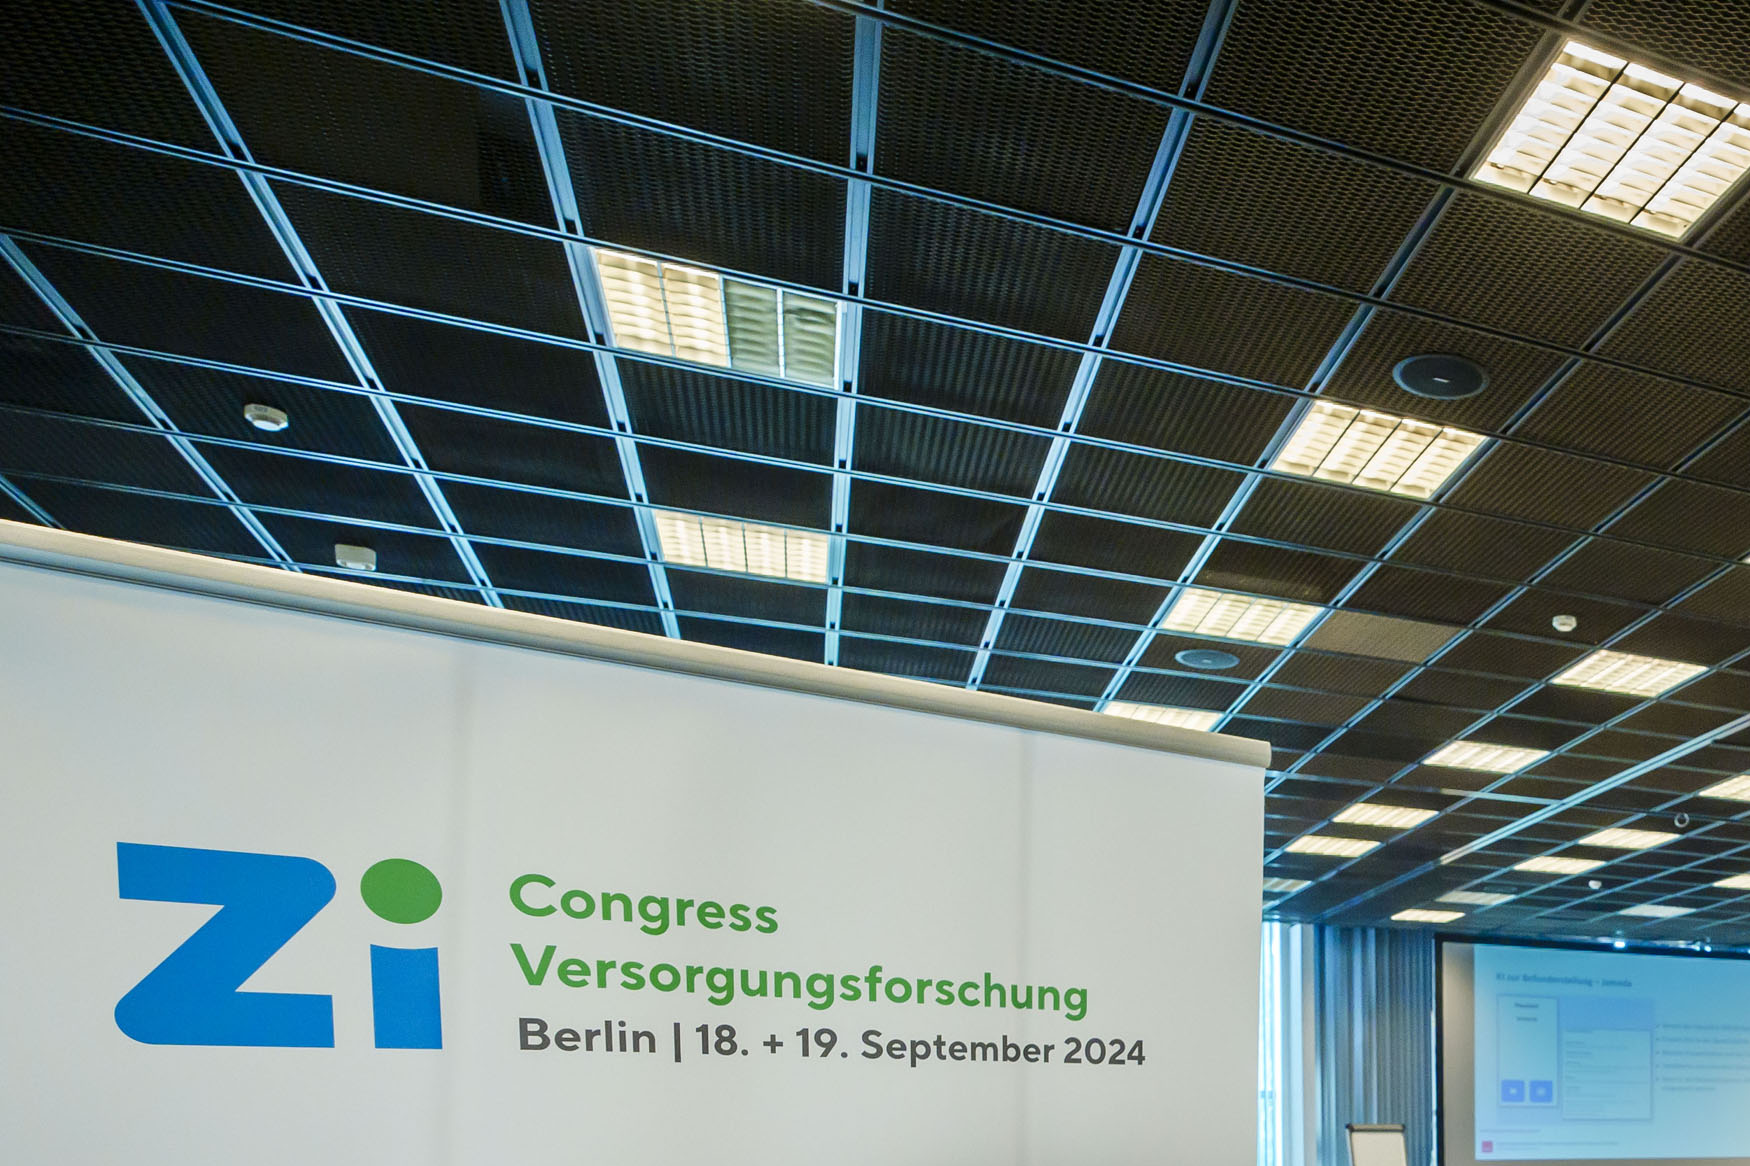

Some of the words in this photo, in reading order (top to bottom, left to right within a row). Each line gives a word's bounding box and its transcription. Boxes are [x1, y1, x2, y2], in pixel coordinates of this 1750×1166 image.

[509, 873, 779, 936] Congress
[114, 841, 443, 1050] Zi
[509, 943, 1088, 1021] Versorgungsforschung
[518, 1017, 656, 1053] Berlin
[695, 1024, 749, 1056] 18.
[763, 1034, 784, 1054] +
[795, 1028, 848, 1059] 19.
[861, 1029, 1055, 1068] September
[1063, 1036, 1146, 1066] 2024
